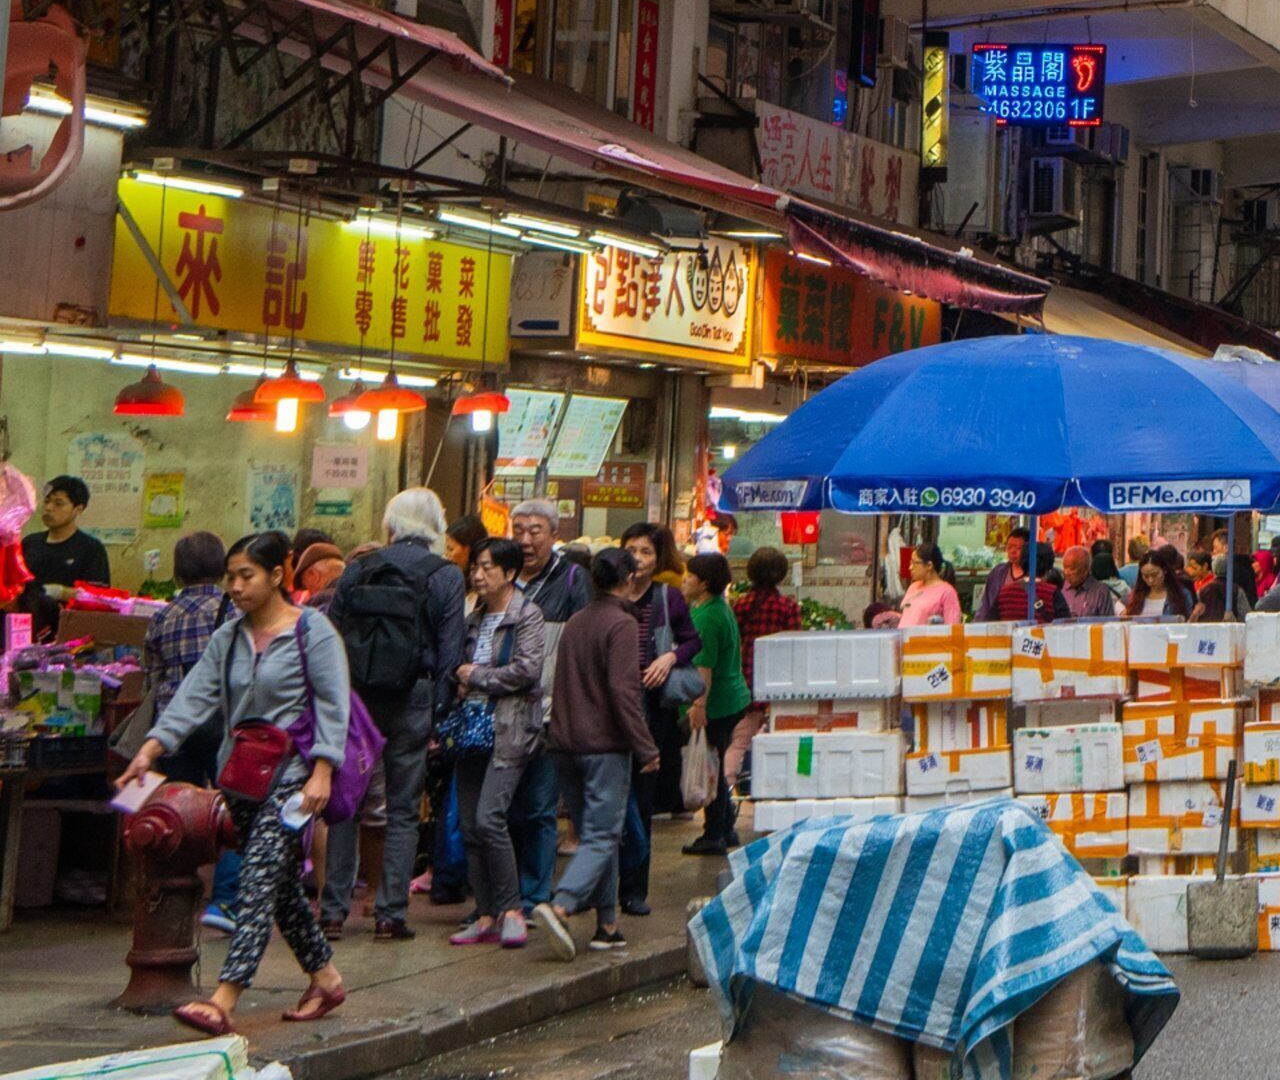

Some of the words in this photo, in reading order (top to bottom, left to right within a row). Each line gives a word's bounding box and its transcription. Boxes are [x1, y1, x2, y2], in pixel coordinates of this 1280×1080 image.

[982, 50, 1065, 83] 紫晶閣
[984, 85, 1066, 99] MASSAGE
[1070, 98, 1096, 119] 1F
[172, 204, 309, 331] 來記
[357, 238, 476, 299] 鮮花菓菜
[354, 289, 475, 348] 零售批發
[858, 488, 918, 506] 商家入駐
[940, 488, 986, 507] 6930
[989, 489, 1036, 508] 3940
[1111, 481, 1225, 506] BFMe.com
